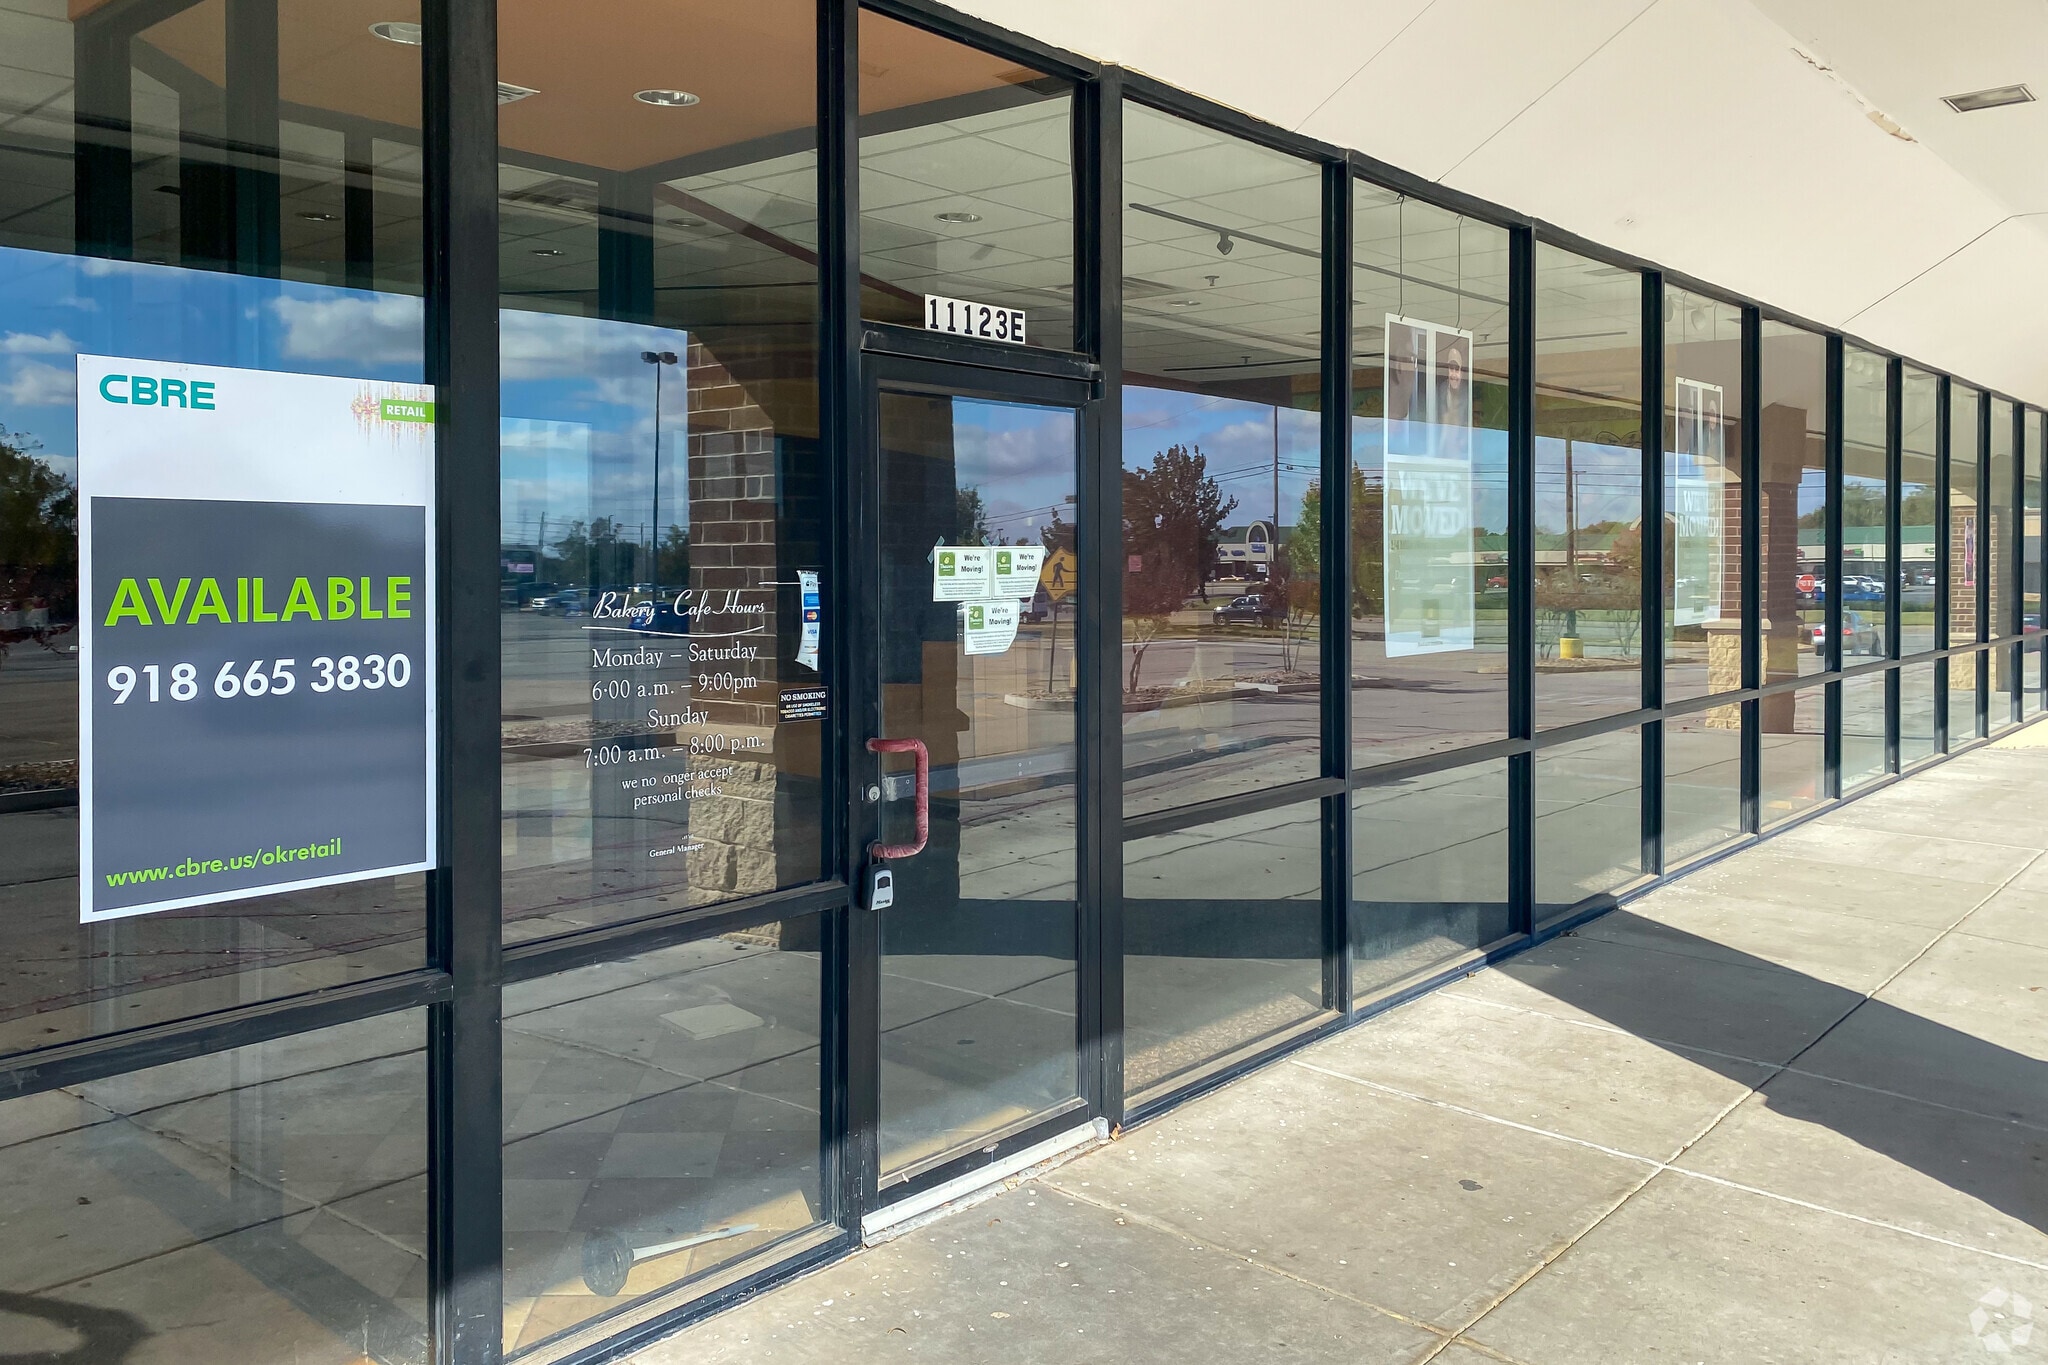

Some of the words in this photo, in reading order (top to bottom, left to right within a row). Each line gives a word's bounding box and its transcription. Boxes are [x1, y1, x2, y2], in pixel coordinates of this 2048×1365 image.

[929, 298, 1024, 342] 11123E
[99, 373, 216, 411] CBRE
[386, 404, 426, 418] RETAIL
[960, 565, 984, 574] Moving!
[964, 554, 981, 562] We're
[1016, 564, 1038, 572] Moving!
[104, 576, 411, 626] AVAILABLE
[593, 591, 656, 625] Bakery
[674, 589, 711, 622] Cafe
[712, 588, 765, 615] Hours
[988, 617, 1012, 626] Moving!
[592, 646, 663, 668] Monday
[688, 640, 758, 663] Saturday
[107, 662, 200, 705] 918
[213, 658, 296, 699] 665
[310, 653, 411, 693] 3830
[637, 682, 675, 698] a.m.
[698, 671, 758, 694] 9:00pm
[780, 693, 792, 702] NO
[792, 691, 826, 701] SMOKING
[647, 706, 709, 727] Sunday
[583, 744, 621, 769] 7:00
[628, 746, 666, 763] a.m.
[690, 733, 724, 755] 8:00
[730, 734, 766, 755] p.m.
[621, 779, 638, 790] we
[641, 776, 657, 788] no
[661, 772, 695, 786] onger
[697, 765, 734, 780] accept
[634, 786, 682, 810] personal
[685, 782, 722, 800] checks
[106, 837, 342, 888] www.cbre.us/okretail
[649, 845, 675, 858] General
[677, 843, 705, 853] Manager
